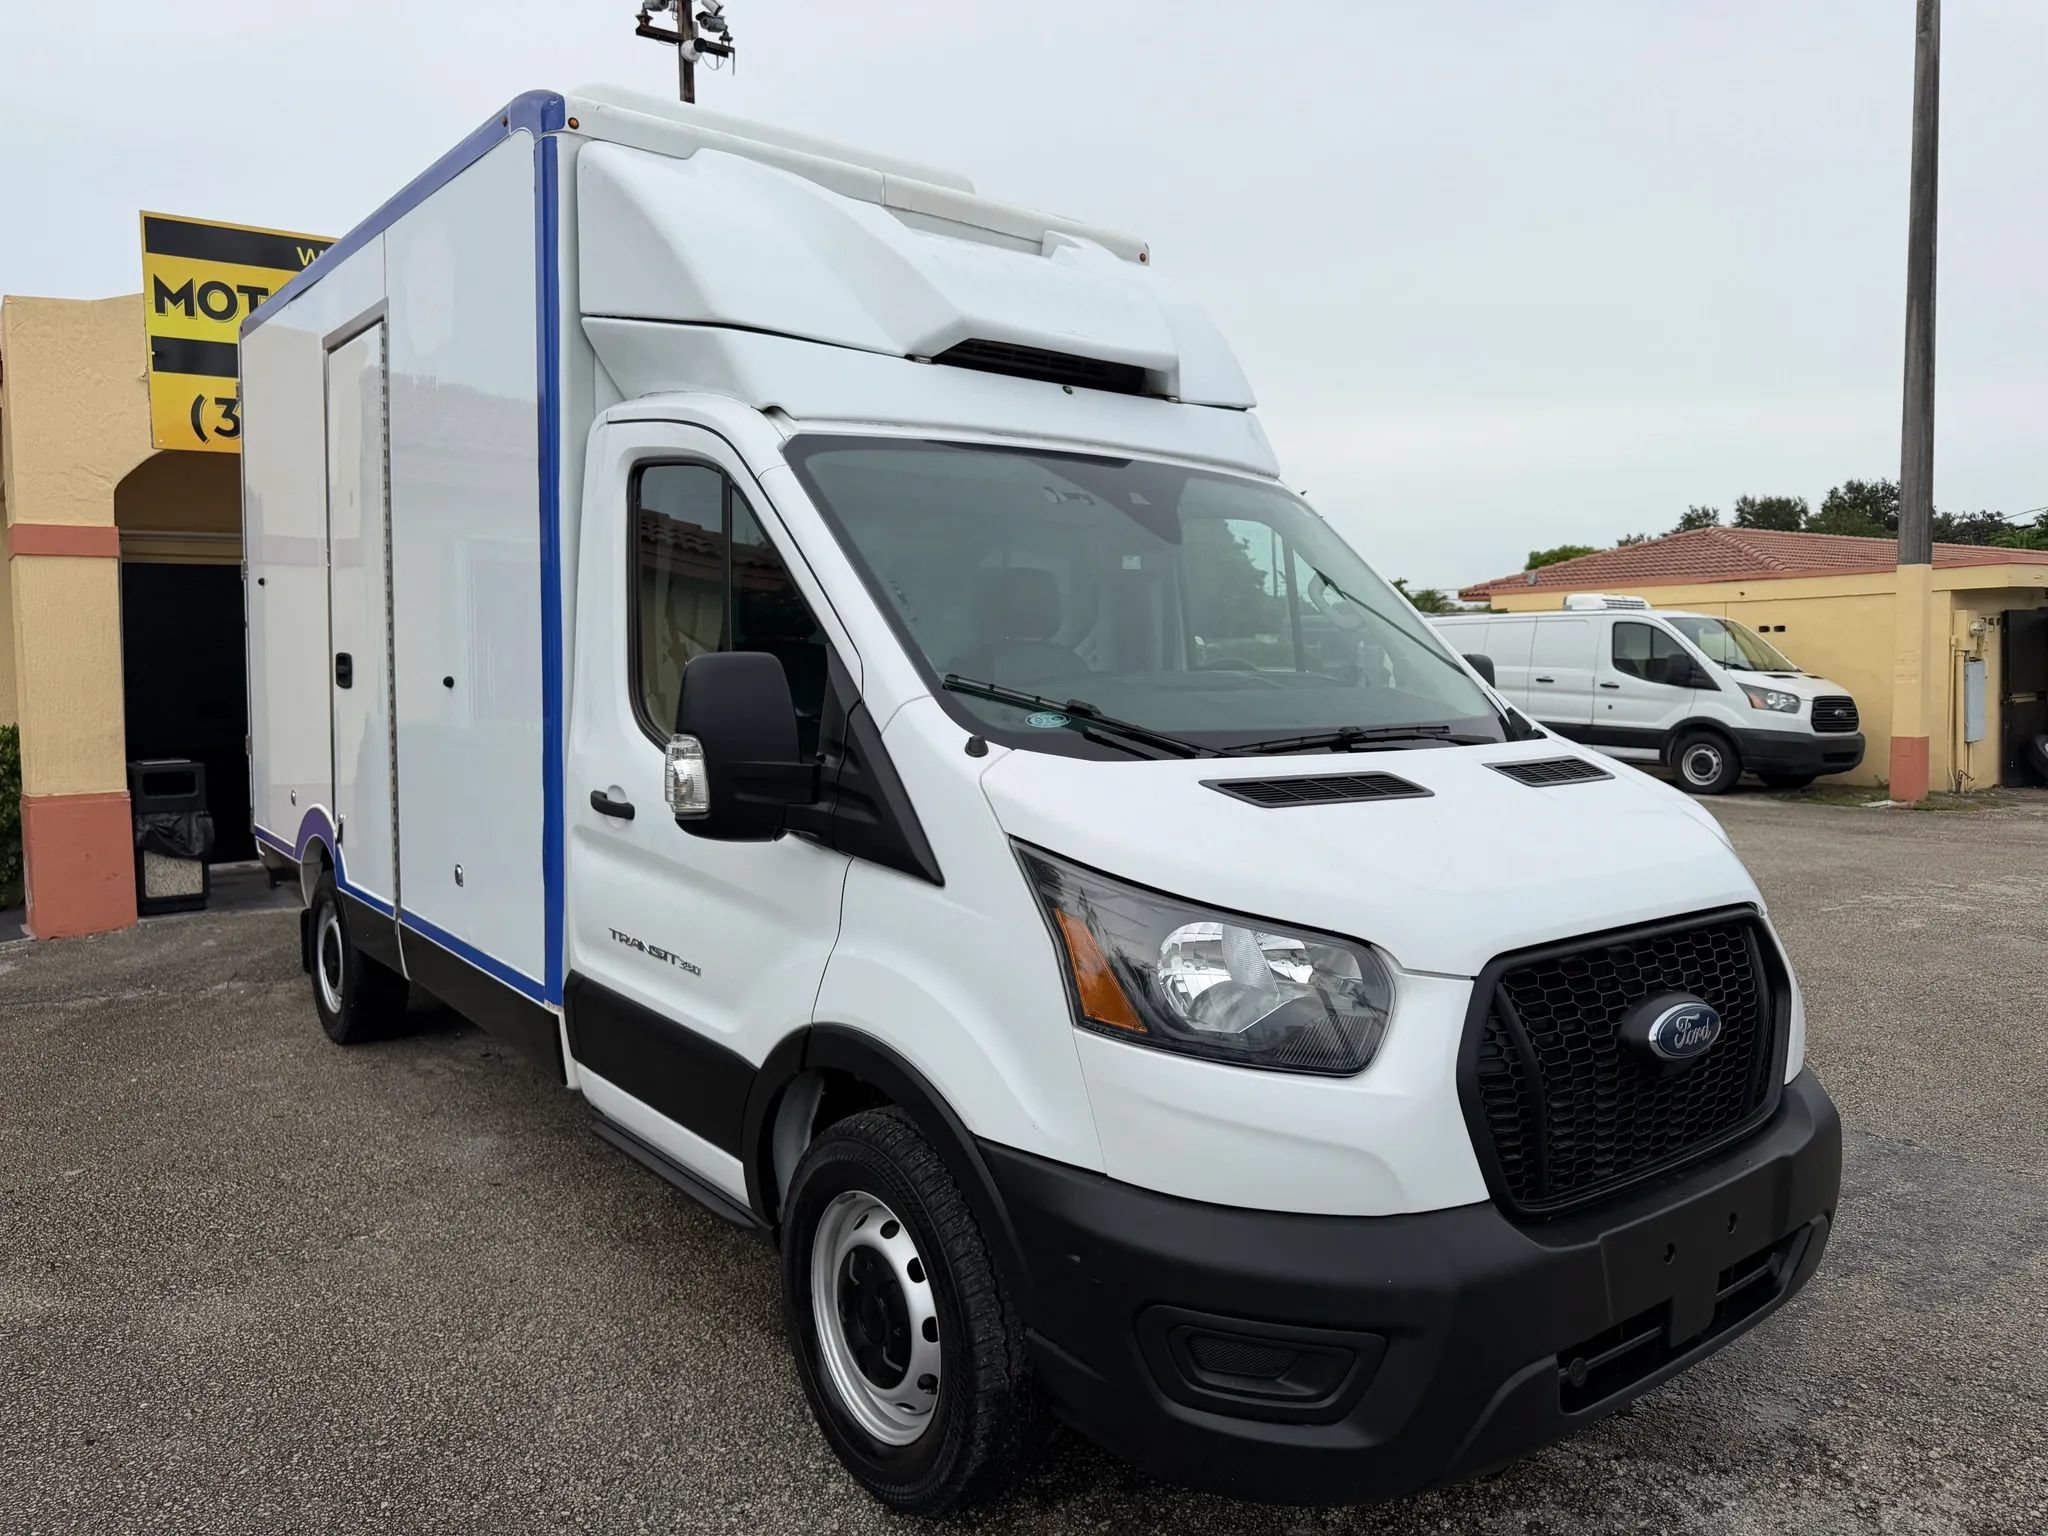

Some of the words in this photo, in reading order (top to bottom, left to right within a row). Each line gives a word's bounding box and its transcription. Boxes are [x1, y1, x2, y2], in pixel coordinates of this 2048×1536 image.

[191, 394, 241, 443] (3
[608, 927, 680, 966] TRANSIT
[1674, 1013, 1712, 1049] Ford
